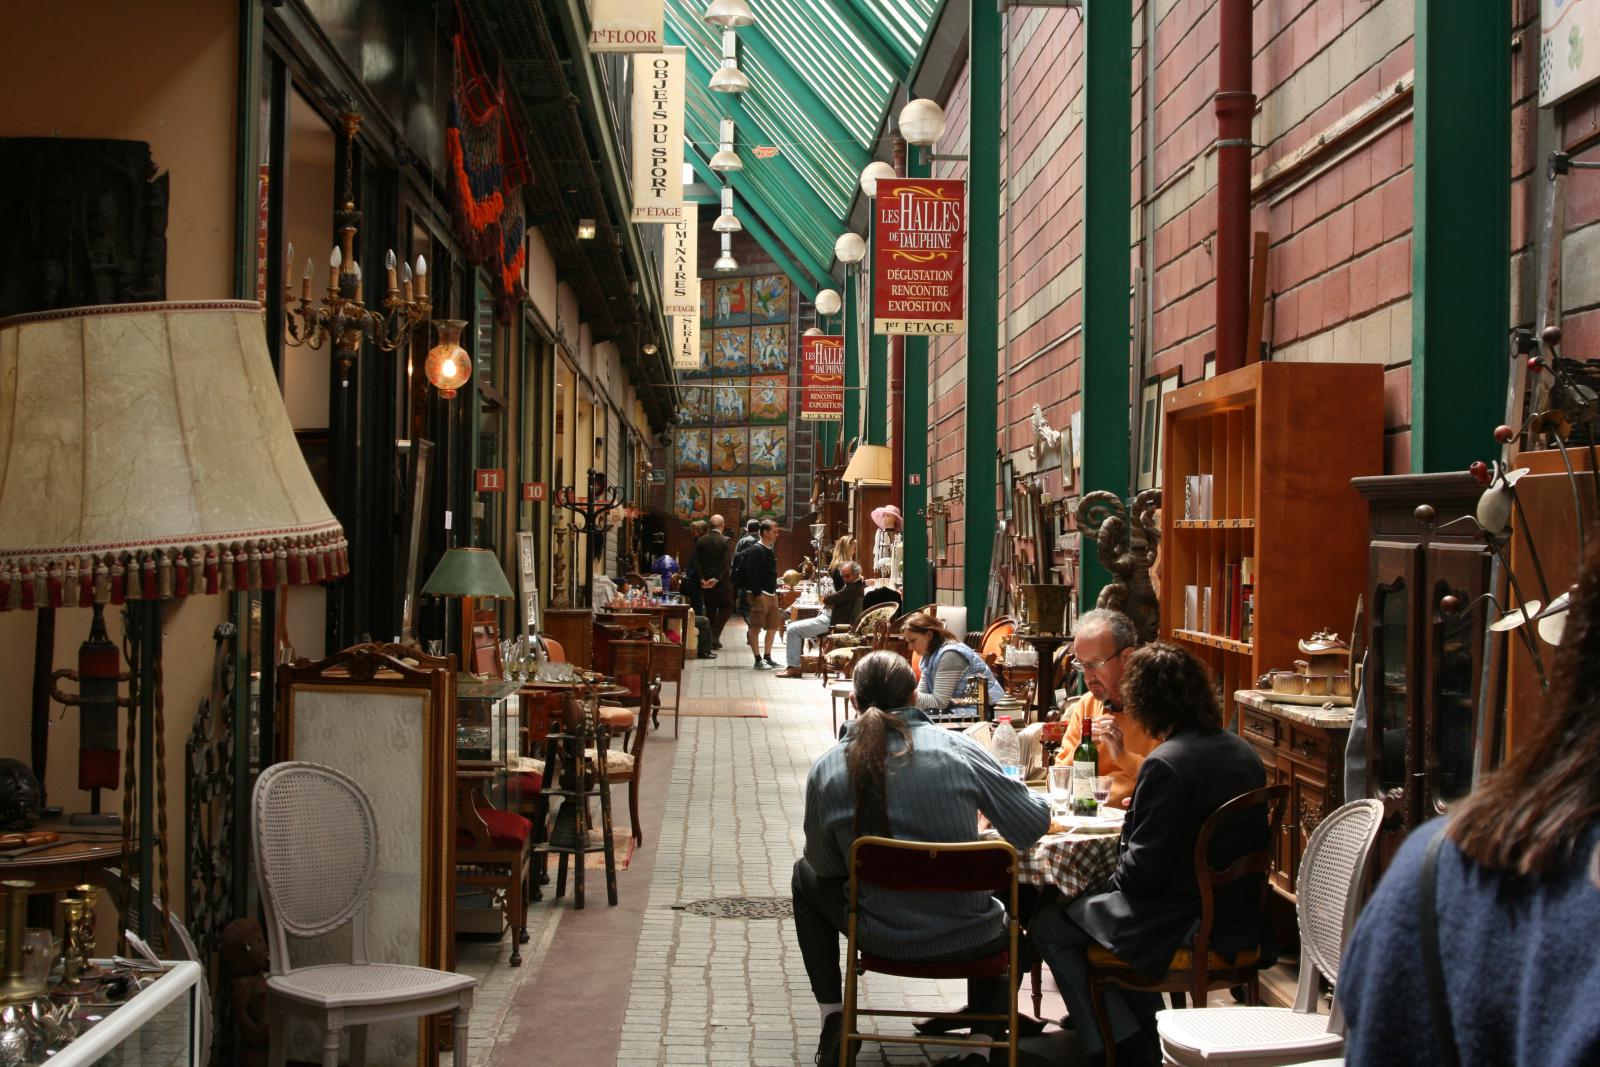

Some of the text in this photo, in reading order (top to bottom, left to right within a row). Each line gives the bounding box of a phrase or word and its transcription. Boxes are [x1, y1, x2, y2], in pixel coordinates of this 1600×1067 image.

[592, 28, 657, 43] 1st FLOOR
[651, 59, 669, 197] OBJETS DU SPORT
[881, 192, 960, 232] LES HALLES
[889, 232, 952, 249] DE DAUPHINE
[675, 219, 687, 297] UMINAIRES
[887, 268, 953, 281] DÉGUSTATION
[891, 285, 949, 297] RENCONTRE
[888, 300, 951, 312] EXPOSITION
[884, 321, 954, 334] 1er ÉTAGE
[805, 351, 815, 360] LES
[481, 473, 500, 488] 11
[527, 486, 542, 498] 10
